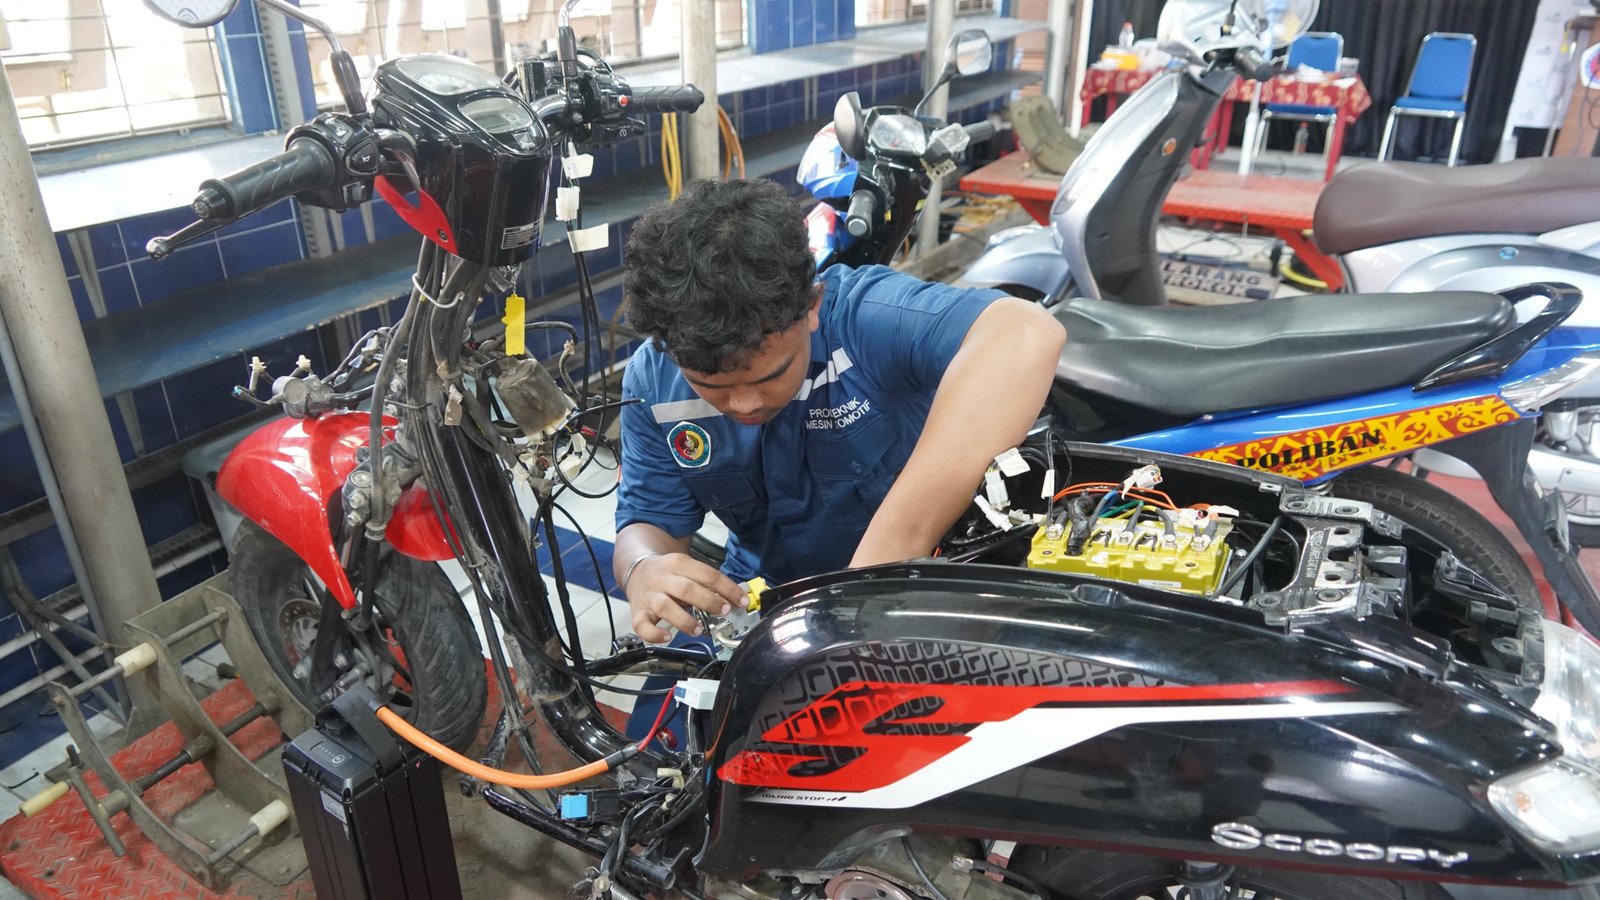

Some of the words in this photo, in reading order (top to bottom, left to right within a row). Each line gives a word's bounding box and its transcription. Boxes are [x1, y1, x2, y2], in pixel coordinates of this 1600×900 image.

[1163, 262, 1261, 285] LARANG
[805, 420, 833, 429] MESIN
[1236, 429, 1382, 468] POLIBAN
